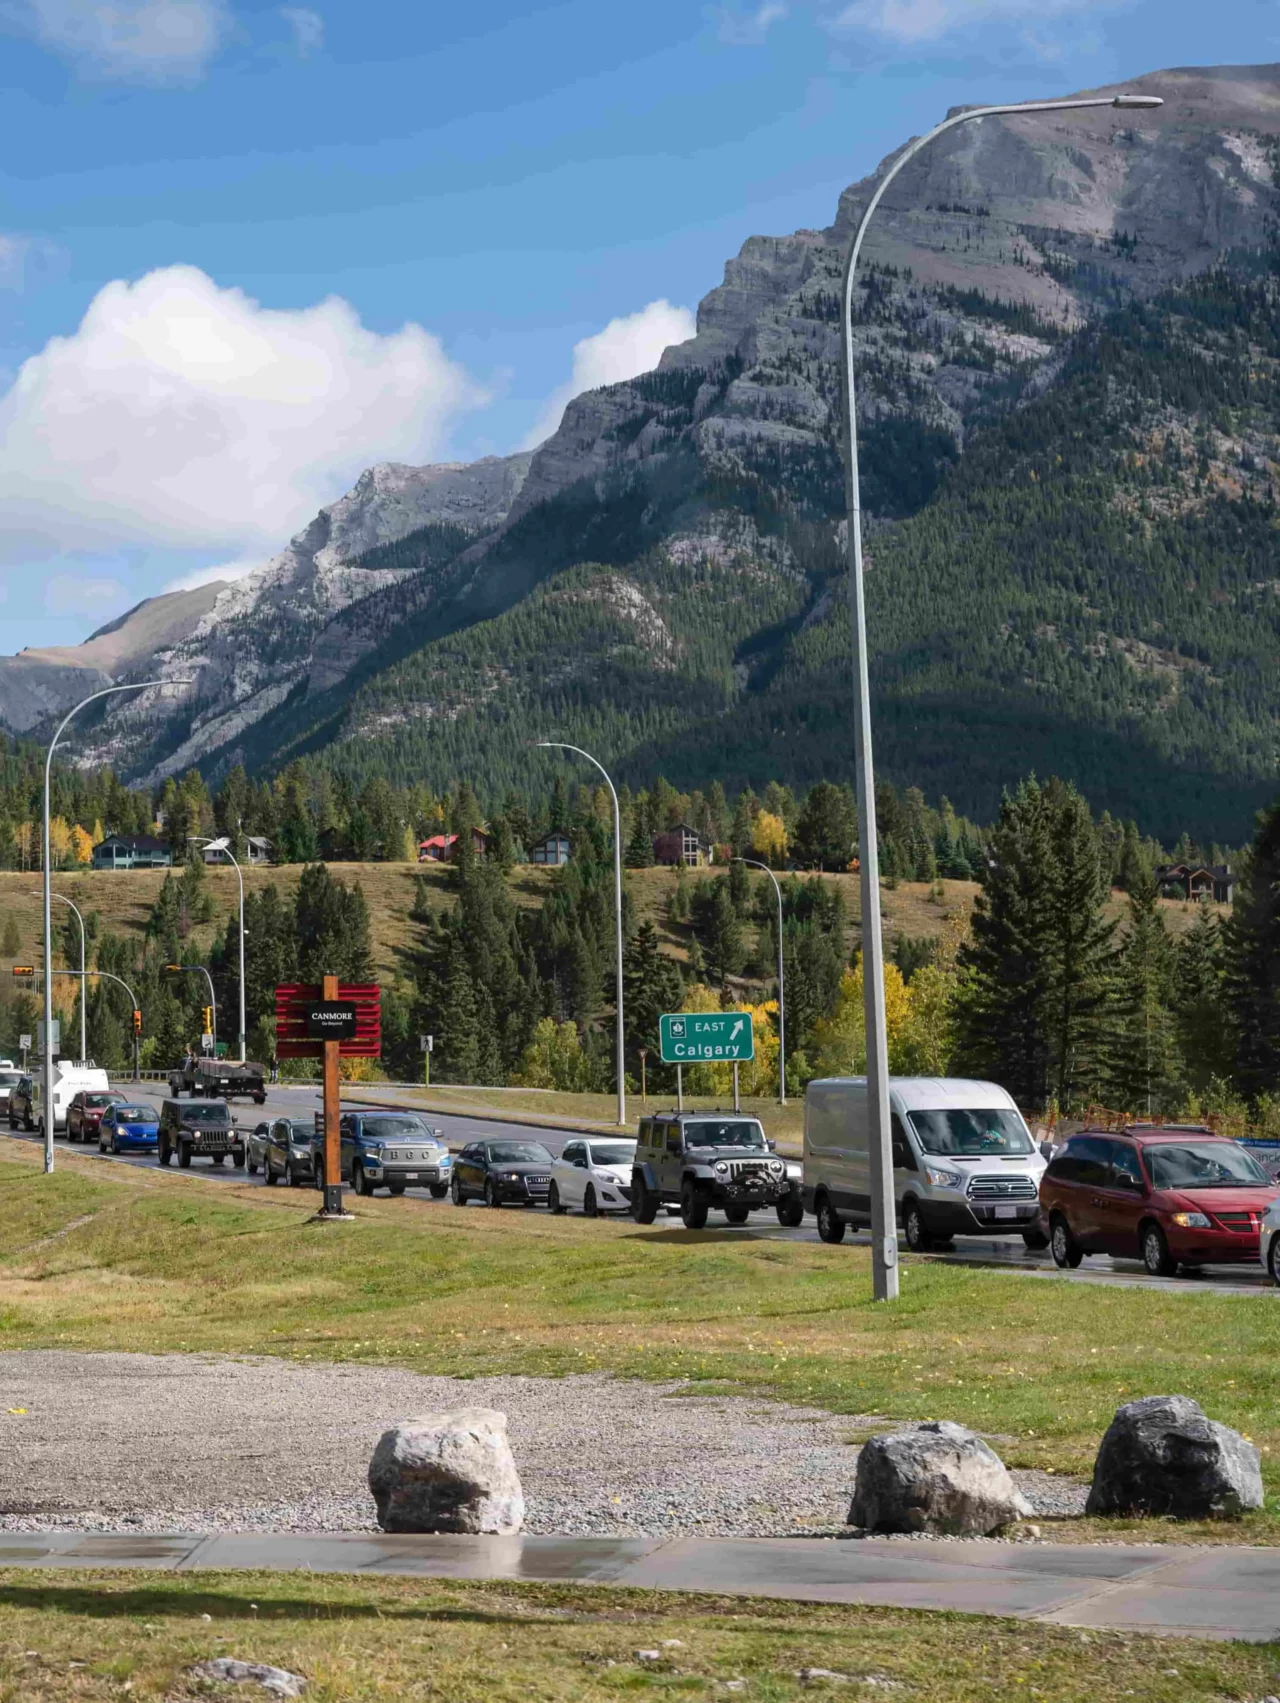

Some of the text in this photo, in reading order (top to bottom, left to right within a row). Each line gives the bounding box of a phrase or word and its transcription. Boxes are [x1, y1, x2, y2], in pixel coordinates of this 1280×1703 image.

[311, 1012, 353, 1020] CANMORE
[695, 1022, 725, 1032] EAST
[674, 1043, 740, 1058] Calgary
